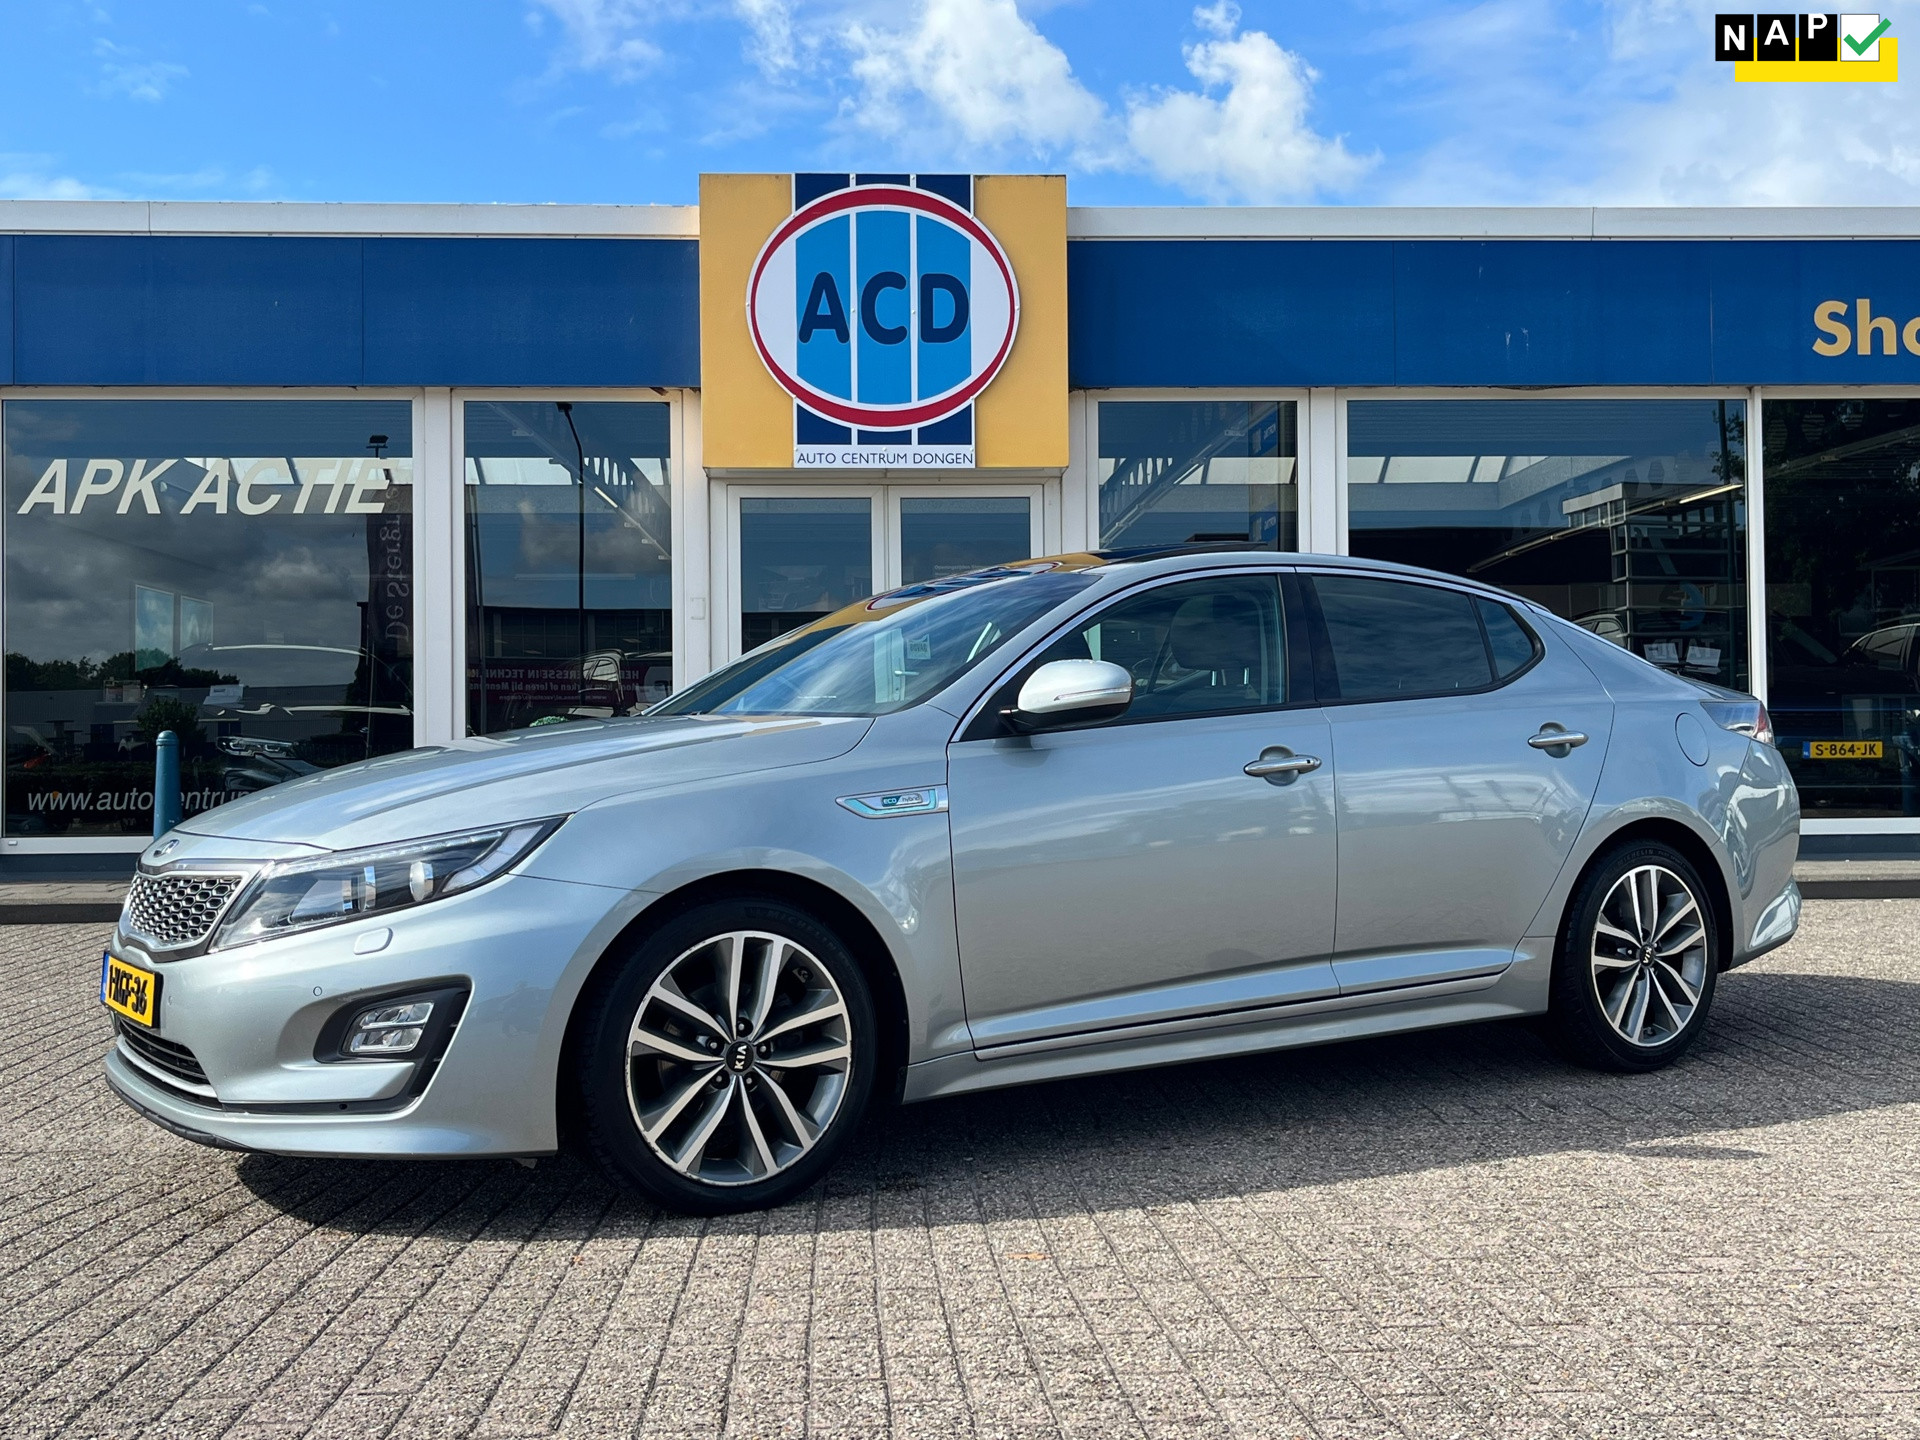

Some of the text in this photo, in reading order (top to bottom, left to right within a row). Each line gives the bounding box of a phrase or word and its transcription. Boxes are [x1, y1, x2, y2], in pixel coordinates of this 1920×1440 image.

[798, 271, 970, 346] ACD
[797, 452, 973, 465] AUTO CENTRUM DONGEN
[17, 458, 400, 515] APK ACTIE
[1815, 743, 1877, 757] S-864-JK
[734, 1045, 747, 1070] KIA
